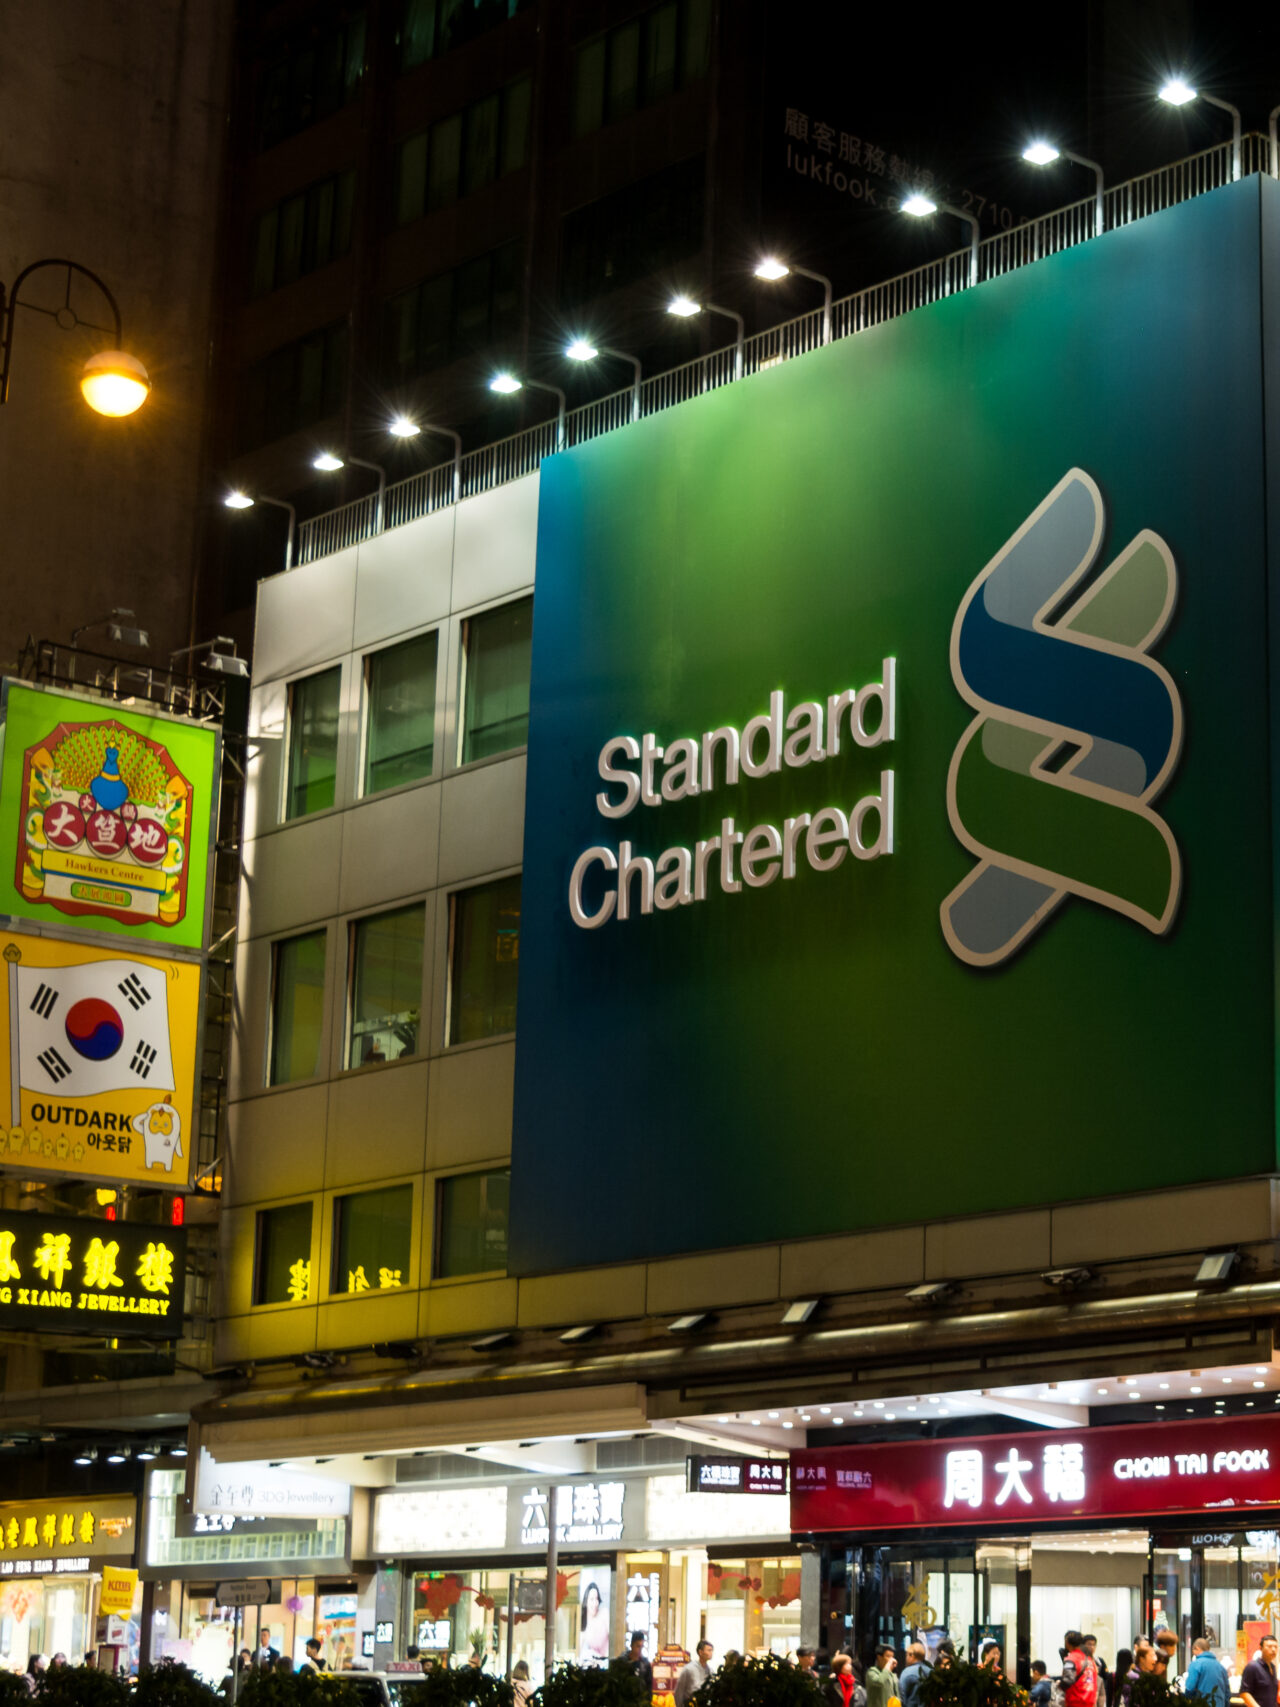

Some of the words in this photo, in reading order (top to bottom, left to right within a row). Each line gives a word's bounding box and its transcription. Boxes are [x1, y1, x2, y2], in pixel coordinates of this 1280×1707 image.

[596, 656, 897, 819] Standard
[568, 769, 895, 929] Chartered
[66, 859, 109, 875] Hawkers
[111, 867, 145, 881] Centre
[31, 1103, 132, 1133] OUTDARK
[86, 1133, 132, 1154] 아웃닭
[18, 1289, 72, 1308] XIANG
[78, 1293, 170, 1316] JEWELLERY
[943, 1442, 1086, 1509] 周大福
[1113, 1455, 1170, 1480] CHOW
[1174, 1453, 1208, 1475] TAI
[1213, 1448, 1270, 1474] FOOK
[287, 1490, 335, 1505] Jewellery
[392, 1662, 421, 1671] TAXI
